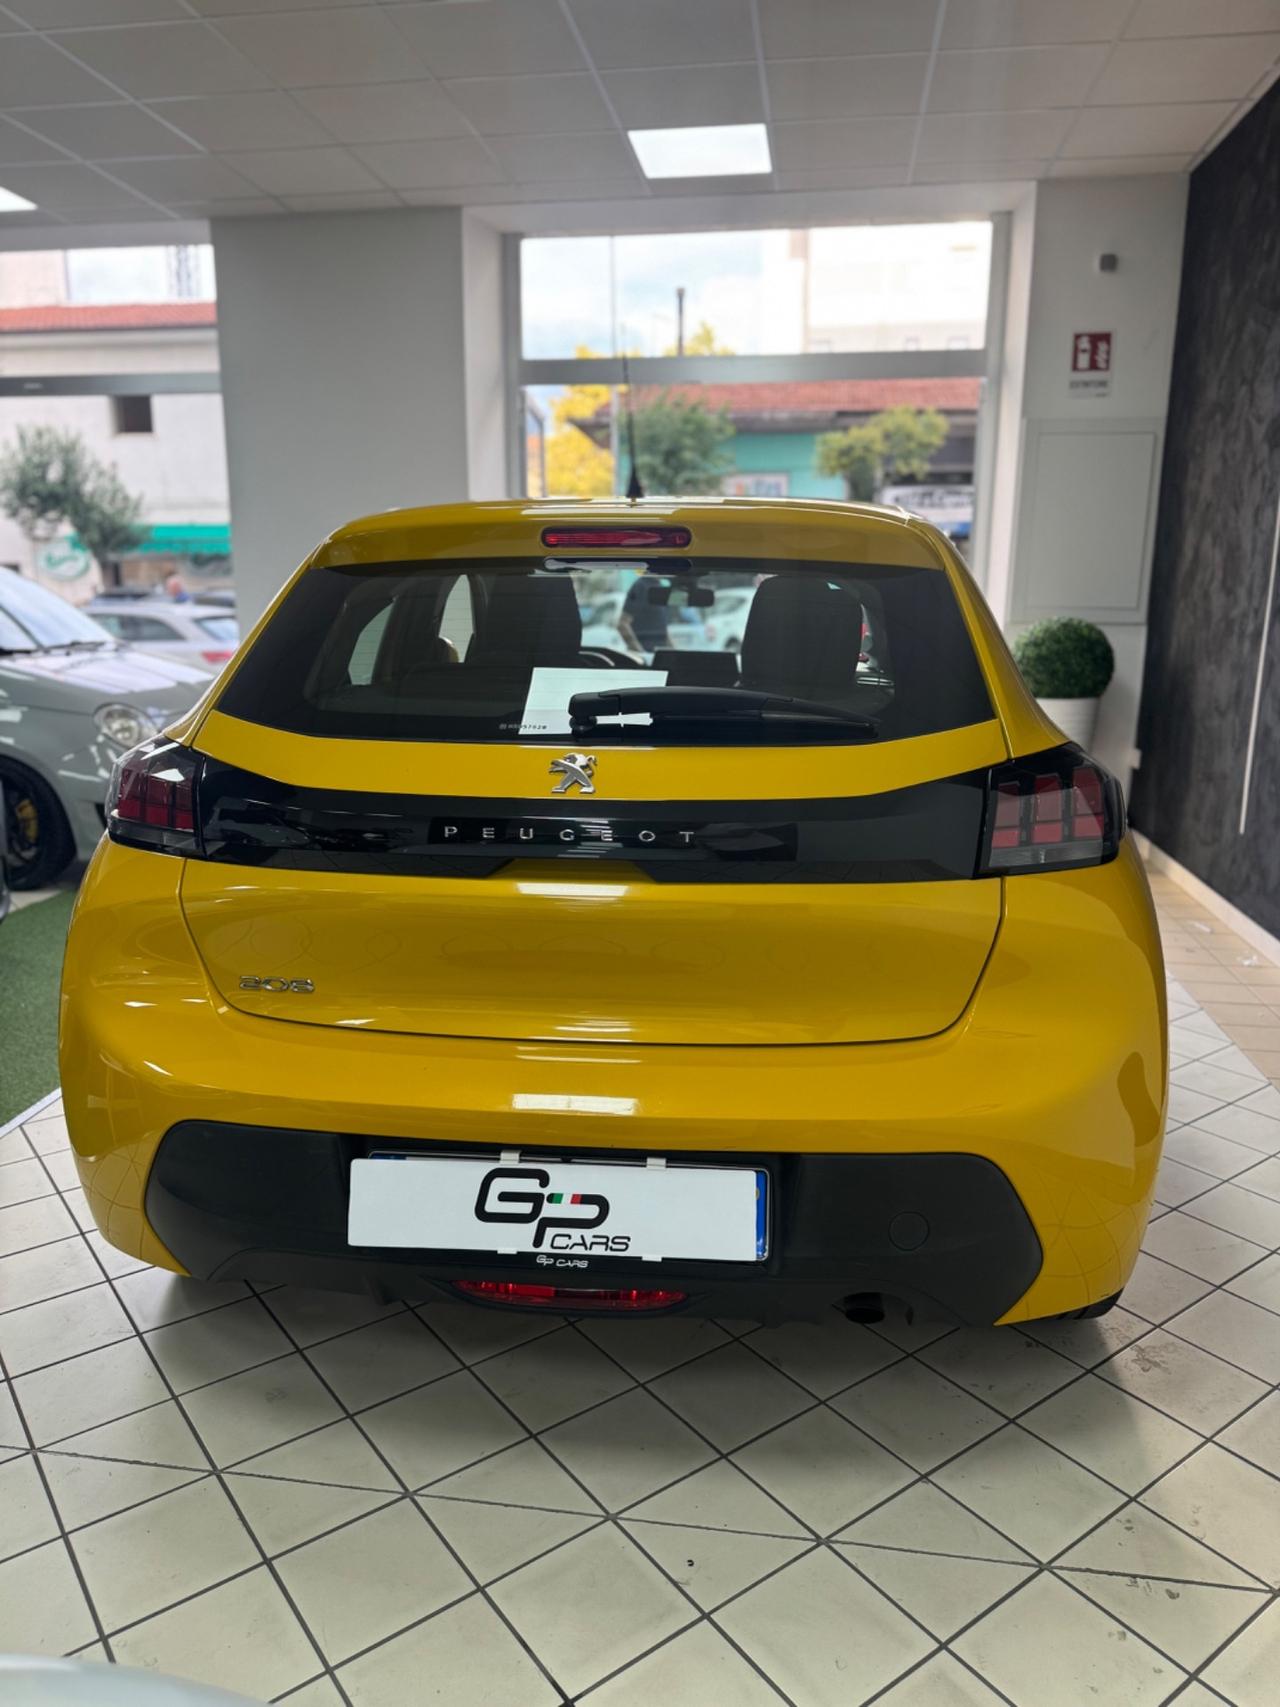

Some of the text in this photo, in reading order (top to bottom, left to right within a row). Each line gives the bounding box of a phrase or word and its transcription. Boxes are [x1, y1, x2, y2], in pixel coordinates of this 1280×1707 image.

[444, 825, 694, 843] PEUGEOT
[240, 975, 314, 992] 208
[475, 1168, 610, 1249] GP
[550, 1233, 631, 1251] CARS
[556, 1259, 589, 1268] CARS
